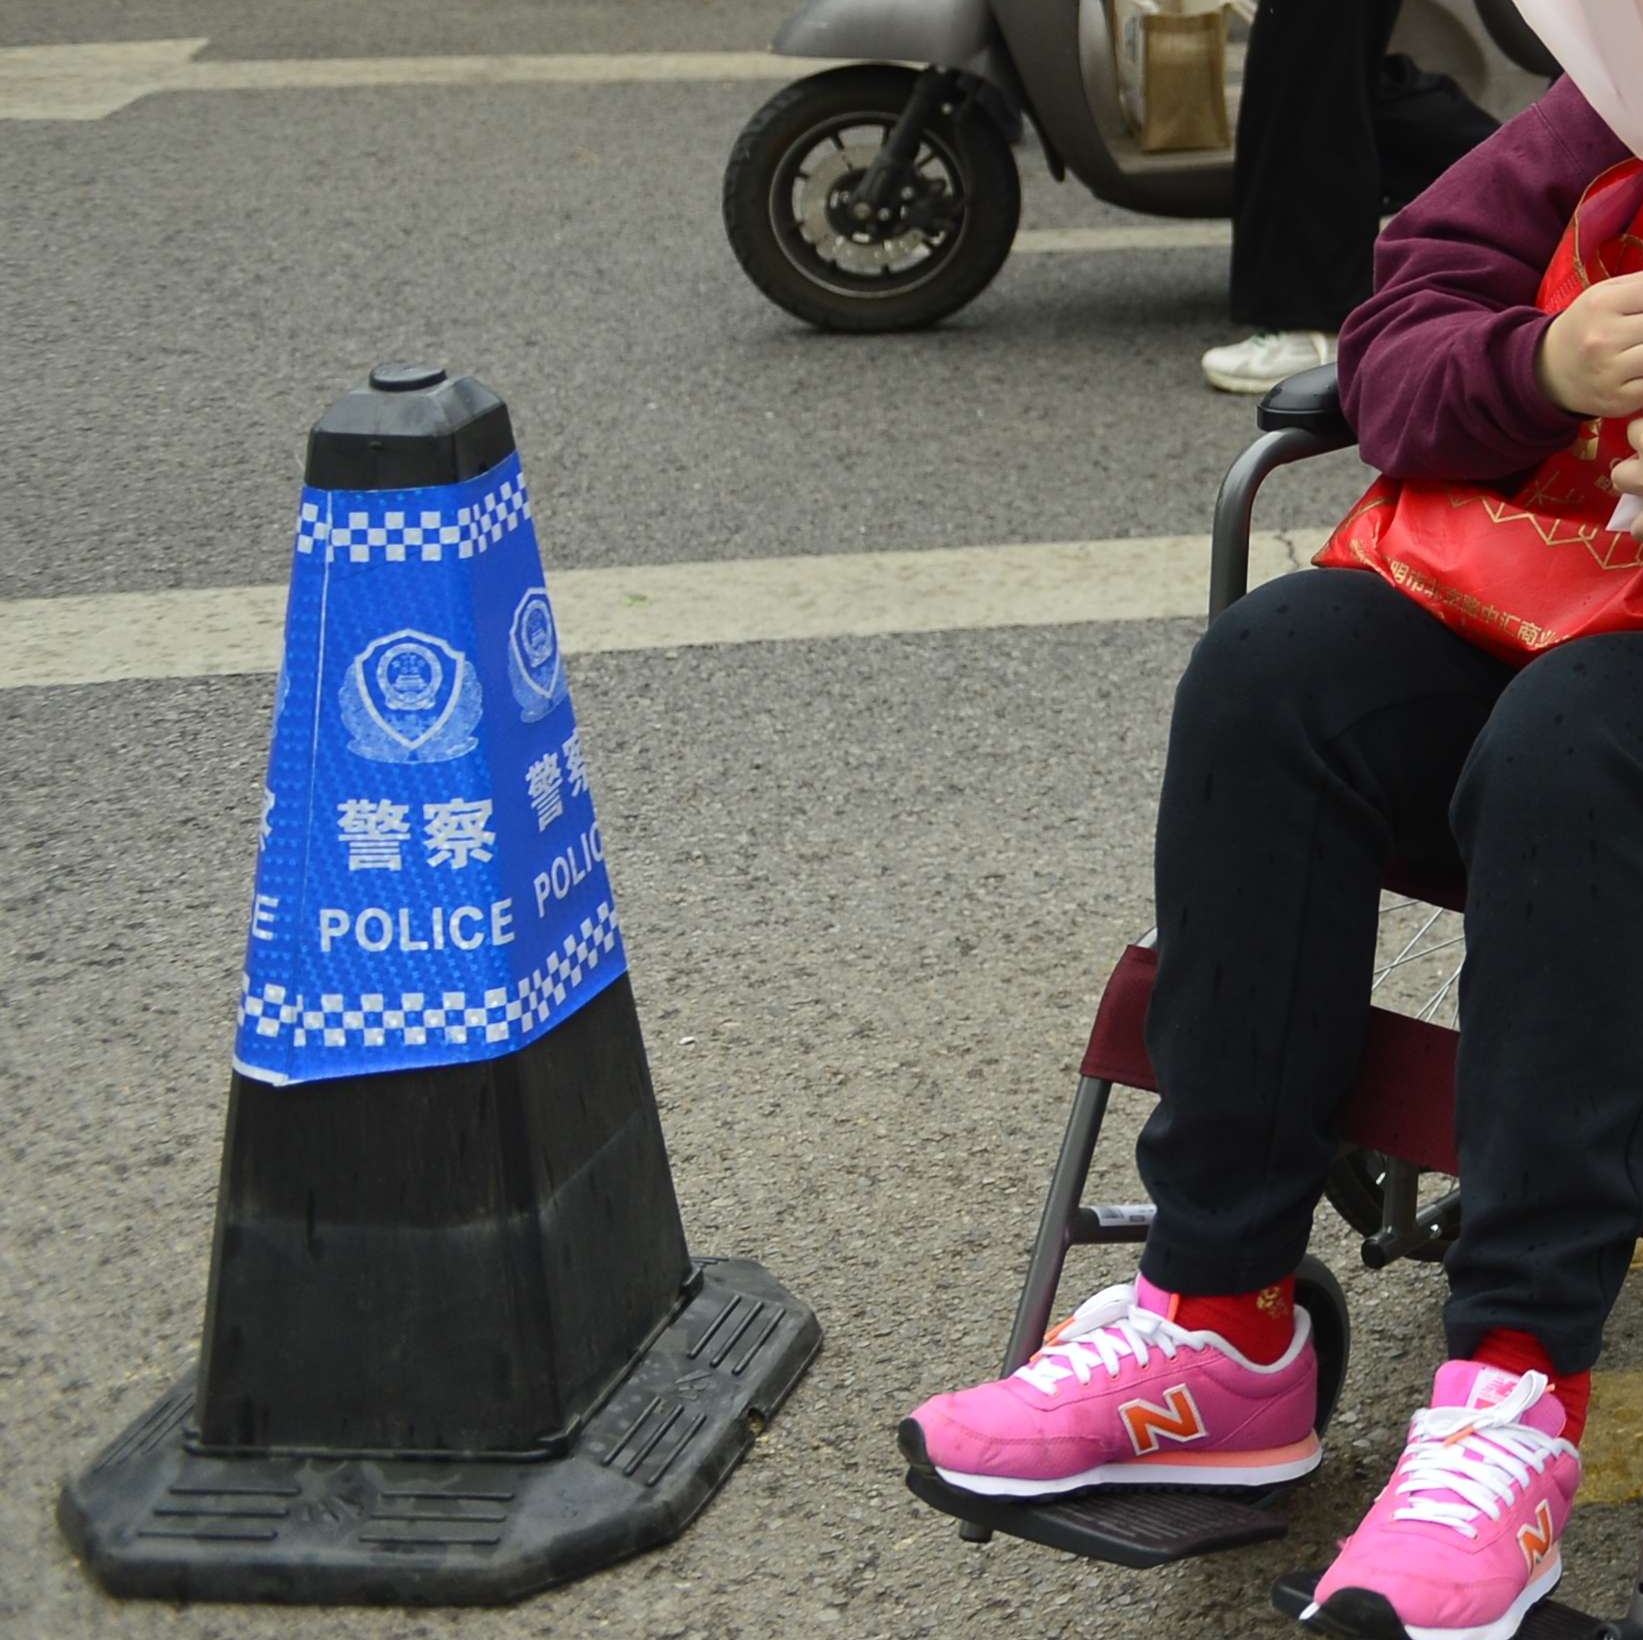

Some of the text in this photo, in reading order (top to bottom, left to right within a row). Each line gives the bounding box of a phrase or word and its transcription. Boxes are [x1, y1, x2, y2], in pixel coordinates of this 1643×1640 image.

[336, 797, 498, 872] 警察
[320, 898, 516, 954] POLICE
[1118, 1382, 1209, 1456] N
[1516, 1499, 1553, 1577] N
